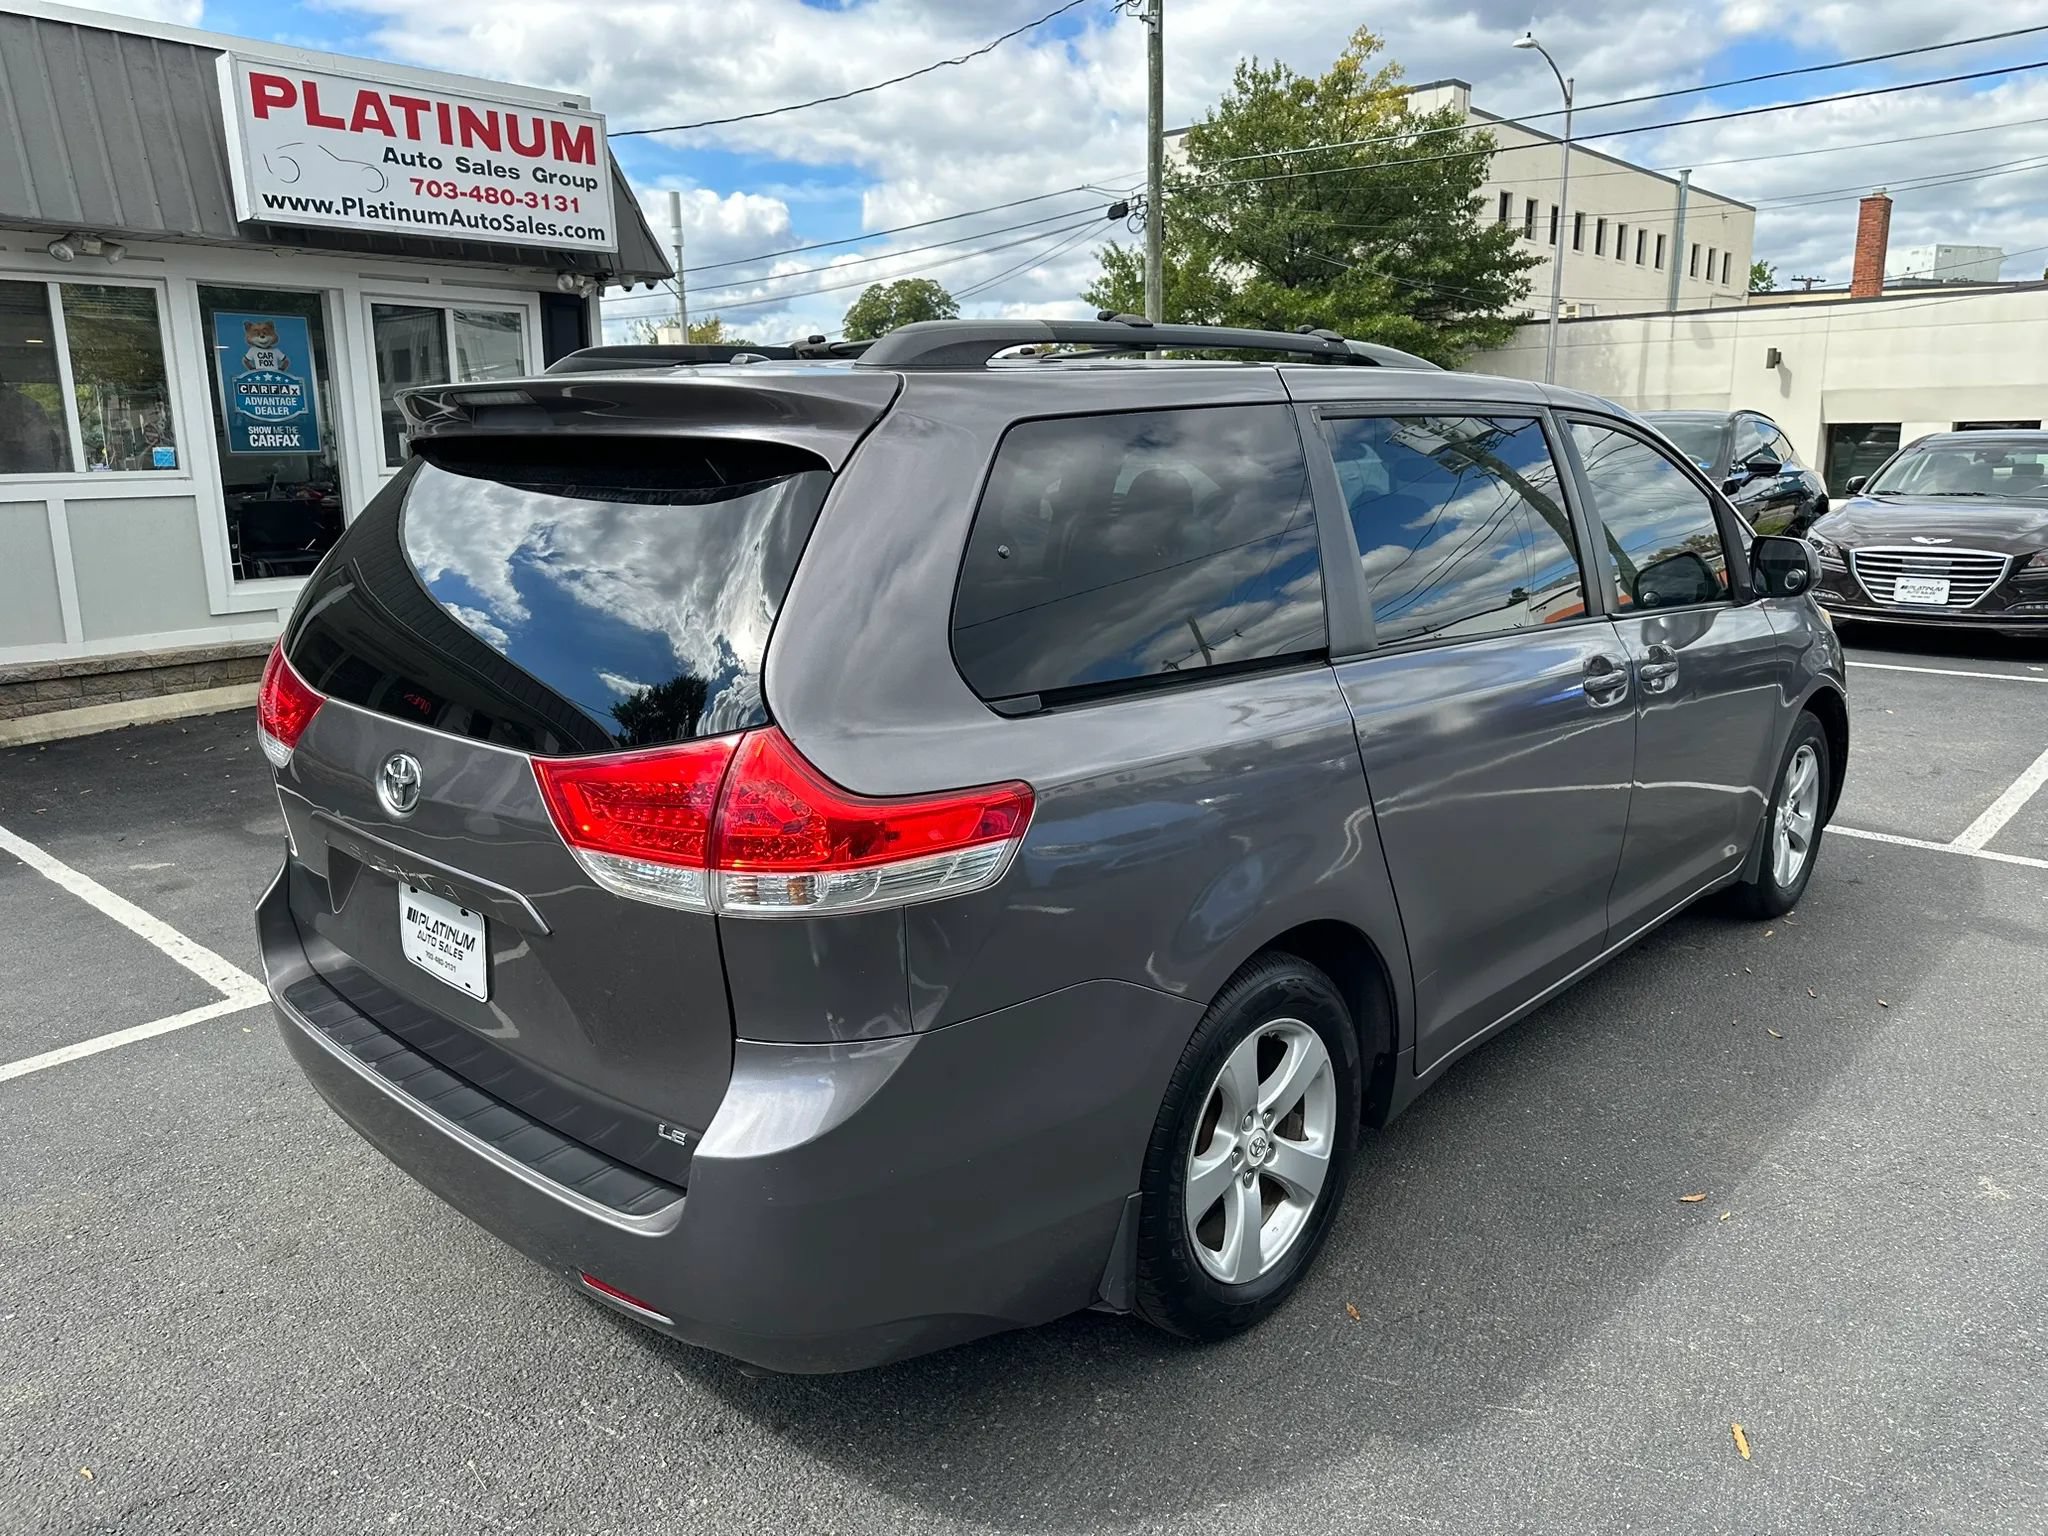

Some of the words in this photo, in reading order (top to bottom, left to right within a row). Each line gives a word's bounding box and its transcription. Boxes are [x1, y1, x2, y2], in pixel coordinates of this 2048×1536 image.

[248, 71, 597, 166] PLATINUM
[382, 146, 443, 170] Auto
[455, 156, 521, 180] Sales
[532, 167, 599, 192] Group
[409, 177, 581, 213] 703-480-3131
[262, 193, 606, 241] www.PlatinumAutoSales.com
[257, 352, 274, 360] CAR
[259, 359, 275, 367] FOX
[239, 384, 300, 396] CARFAX
[245, 397, 297, 406] ADVANTAGE
[254, 406, 290, 416] DEALER
[247, 426, 272, 435] SHOW
[273, 426, 285, 434] ME
[285, 426, 299, 434] THE
[250, 434, 300, 447] CARFAX
[418, 912, 476, 953] PLATINUM
[416, 930, 438, 948] AUTO
[438, 940, 464, 961] SALES
[658, 1123, 688, 1146] LE
